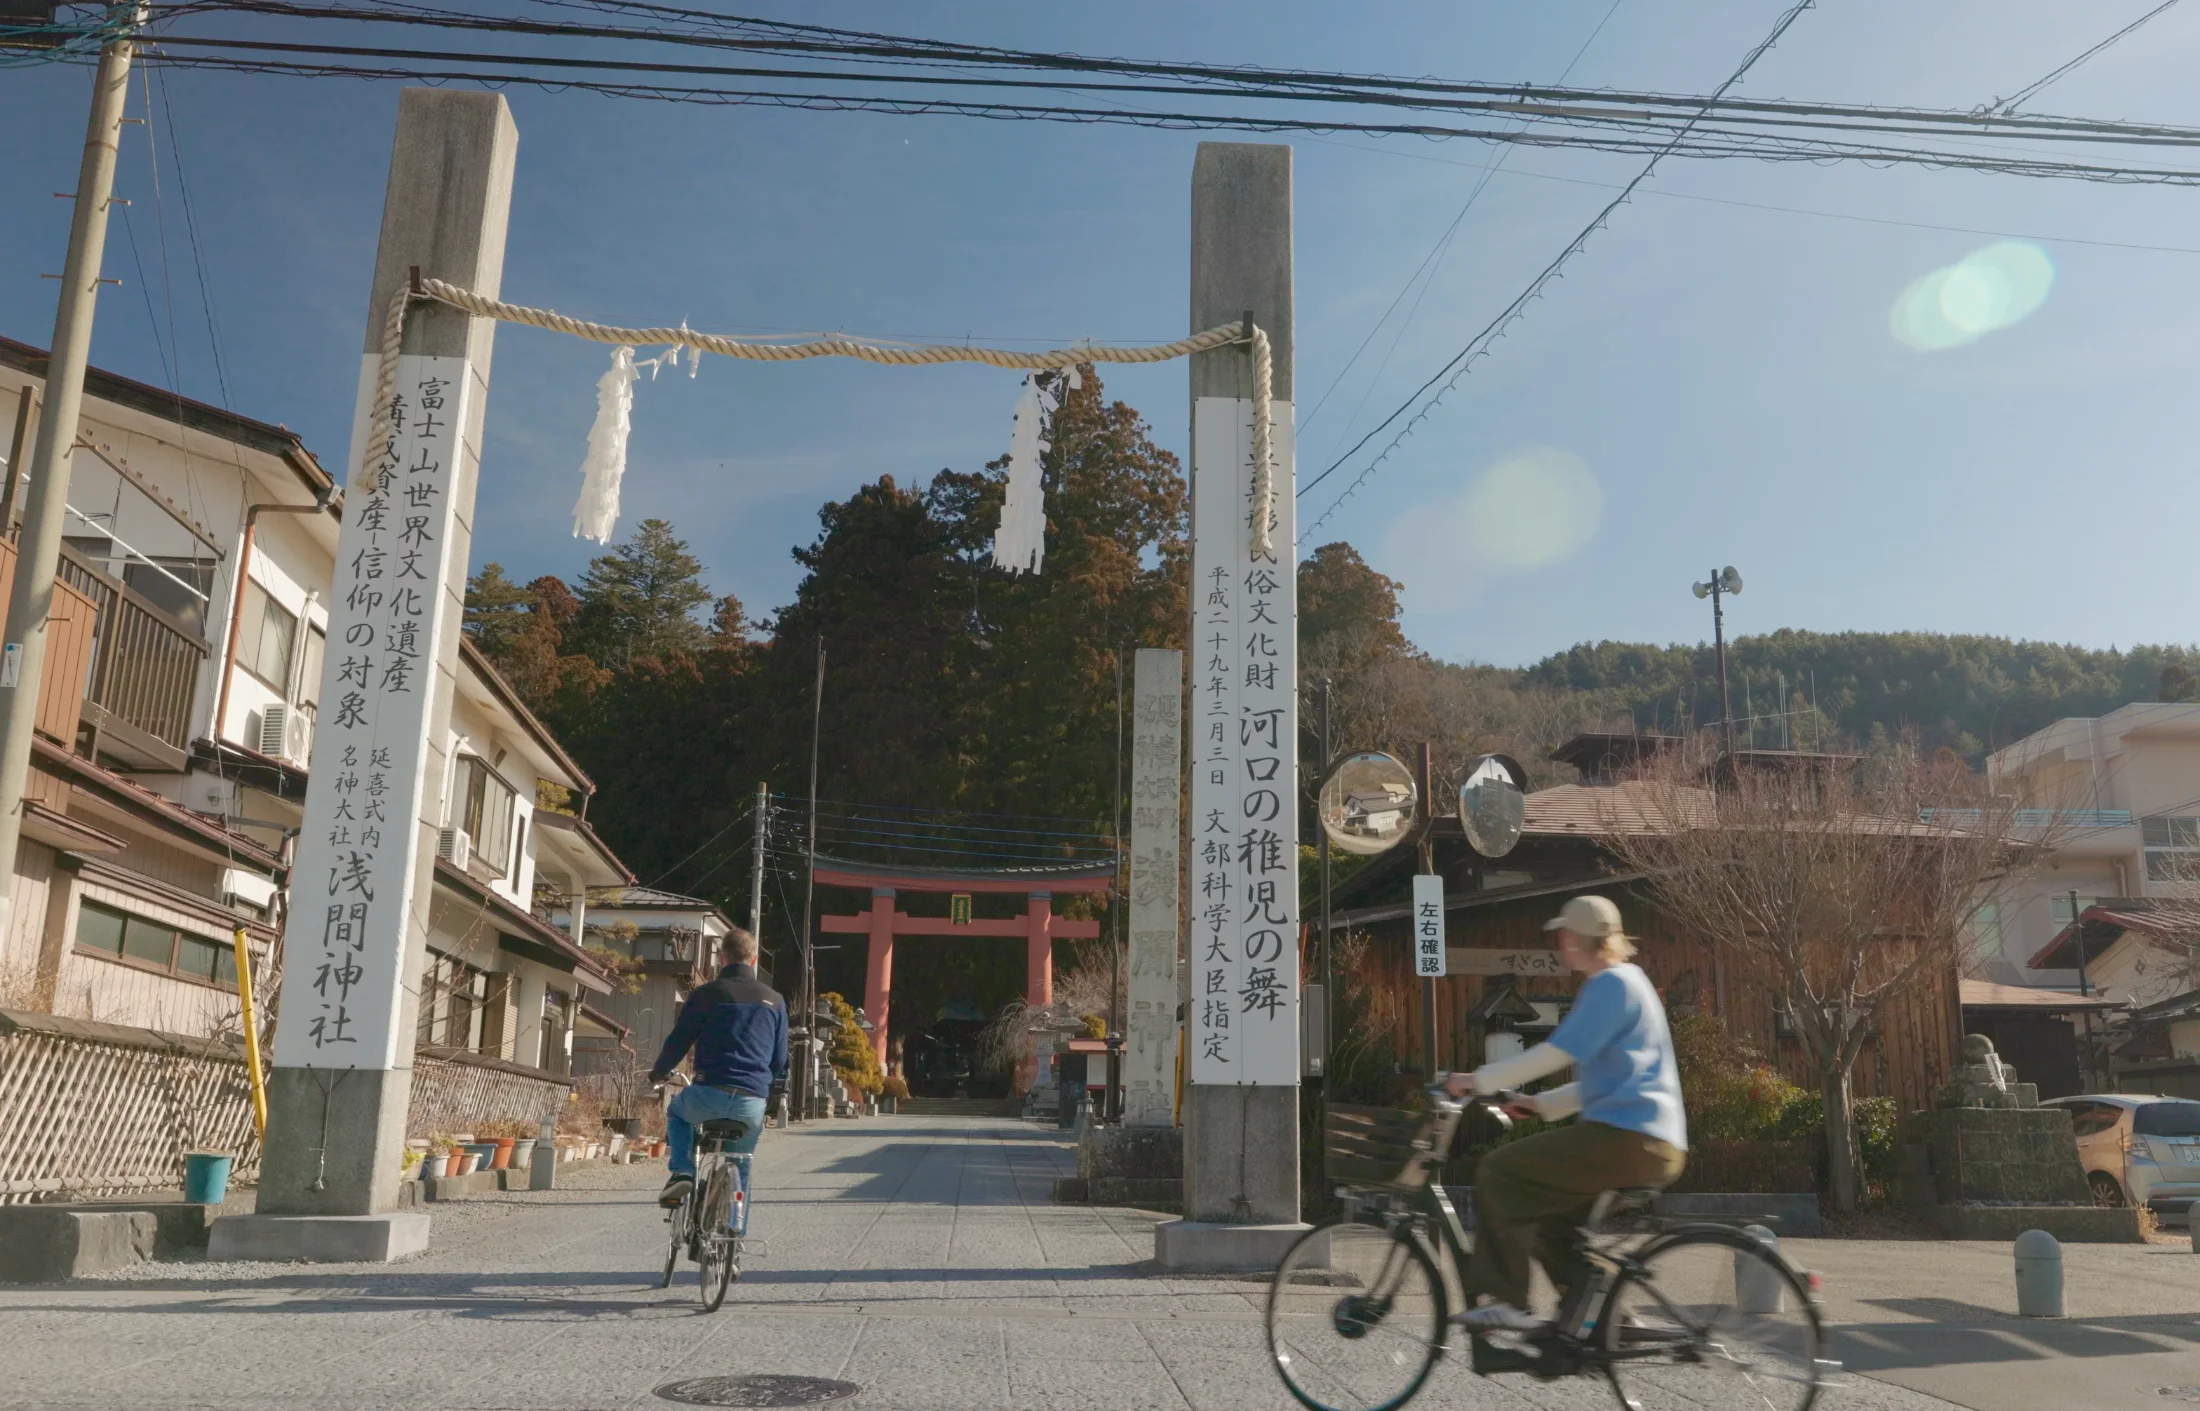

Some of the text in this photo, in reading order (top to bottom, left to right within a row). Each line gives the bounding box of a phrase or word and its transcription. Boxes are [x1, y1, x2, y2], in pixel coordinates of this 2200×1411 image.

[378, 375, 451, 695] 富士山世界文化遺産
[1206, 566, 1231, 786] 平成二十九年三月三日
[327, 744, 359, 848] 名神大社
[360, 747, 394, 850] 延喜式内
[1236, 706, 1289, 1023] 河口の稚児の舞
[308, 850, 375, 1050] 浅間神社
[1199, 808, 1234, 1064] 文部科学大臣指定
[1419, 901, 1440, 974] 左右確認
